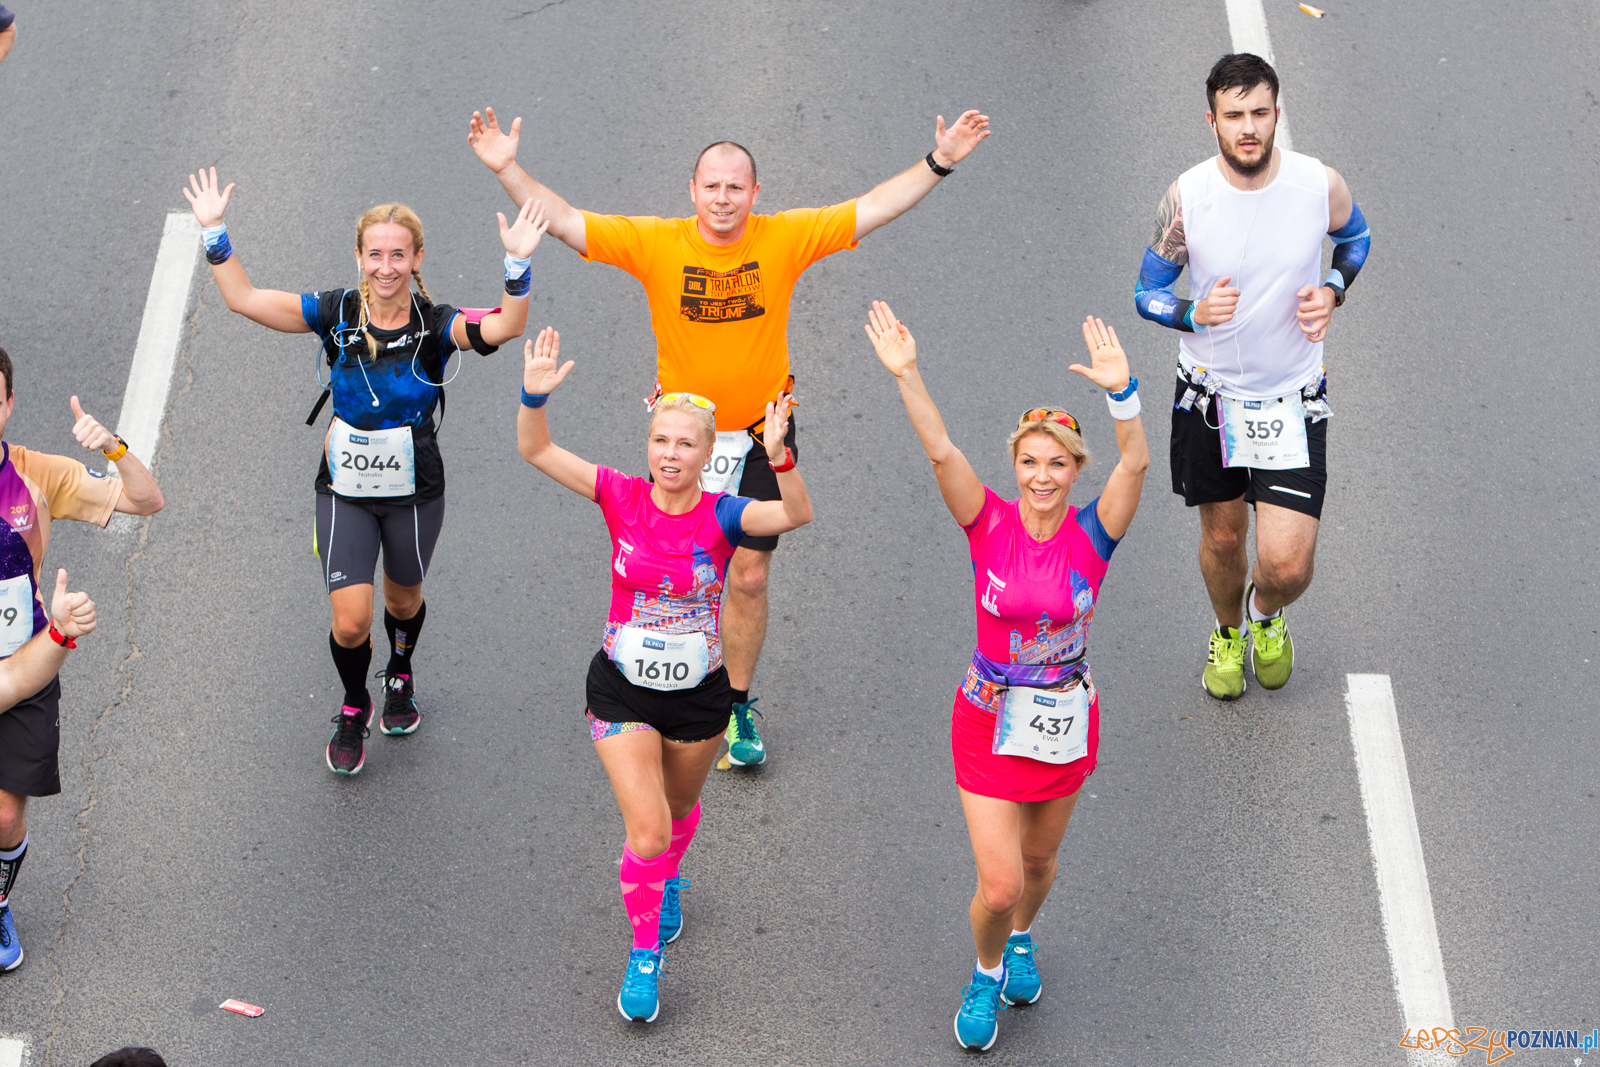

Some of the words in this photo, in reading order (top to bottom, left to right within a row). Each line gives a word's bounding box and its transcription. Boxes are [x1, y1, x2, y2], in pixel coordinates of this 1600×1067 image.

[688, 281, 703, 291] JBL
[710, 271, 760, 292] TRIATHLON
[700, 306, 747, 319] TRIUMF
[1244, 419, 1284, 439] 359
[341, 451, 401, 471] 2044
[10, 504, 29, 514] 2017
[635, 658, 689, 681] 1610
[642, 680, 678, 688] Agnieszka
[1029, 714, 1074, 735] 437
